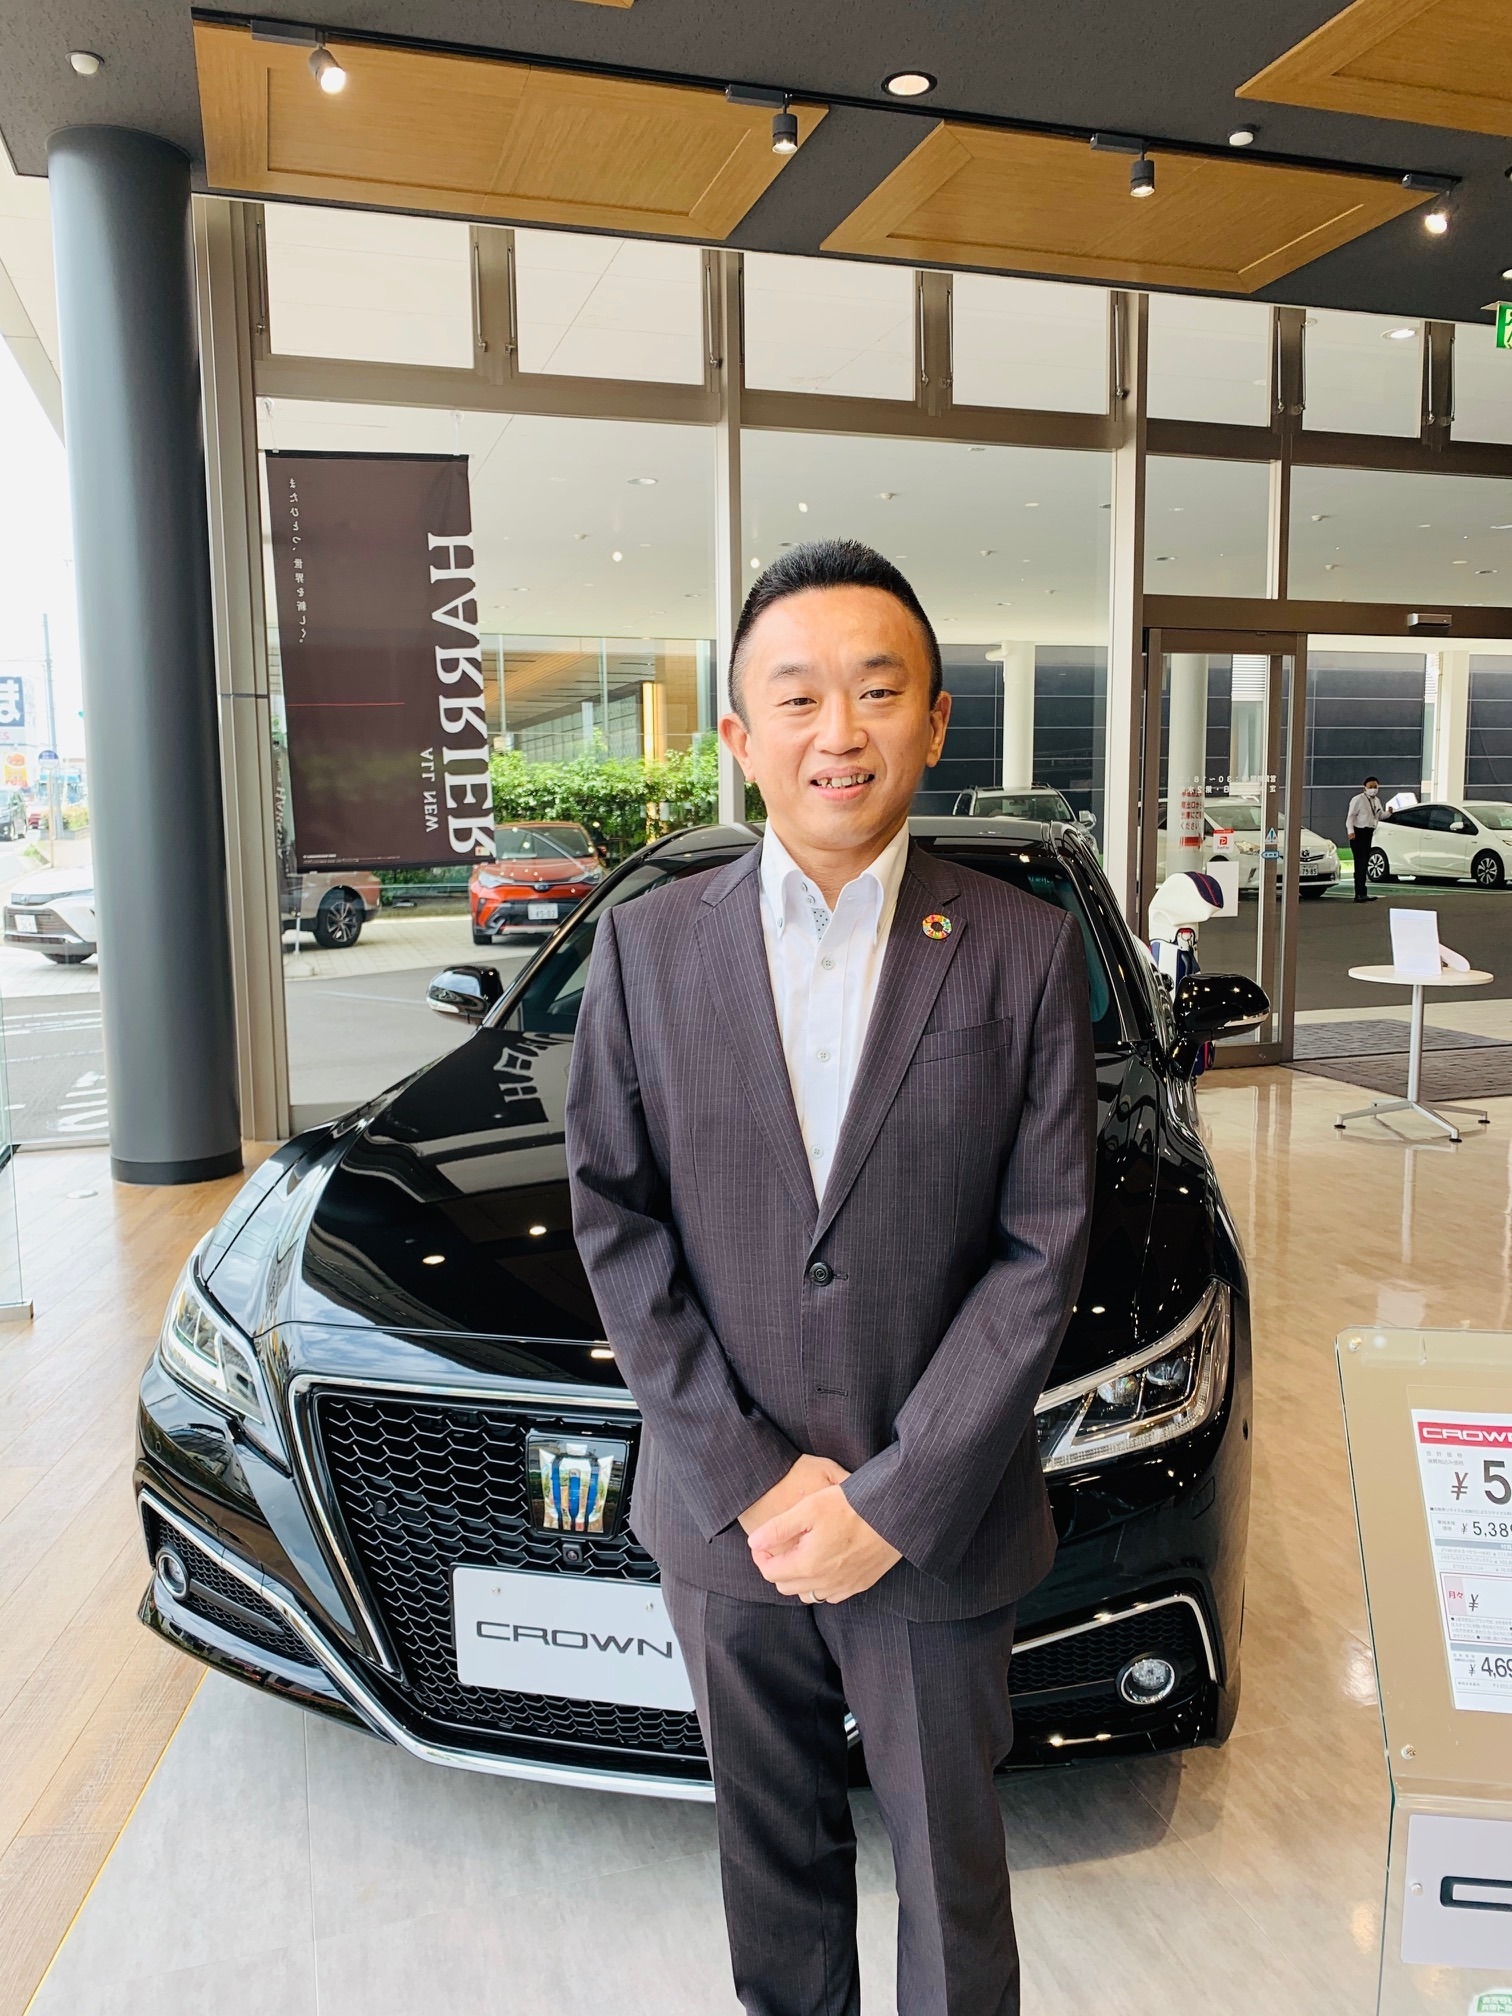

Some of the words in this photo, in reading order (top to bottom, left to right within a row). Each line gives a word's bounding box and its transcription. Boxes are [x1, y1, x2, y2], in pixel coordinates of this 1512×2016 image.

[1422, 1427, 1512, 1443] CROW
[1483, 1459, 1512, 1506] 5
[1472, 1521, 1512, 1538] 5,38
[1448, 1591, 1463, 1599] 月々
[476, 1620, 673, 1659] CROWN
